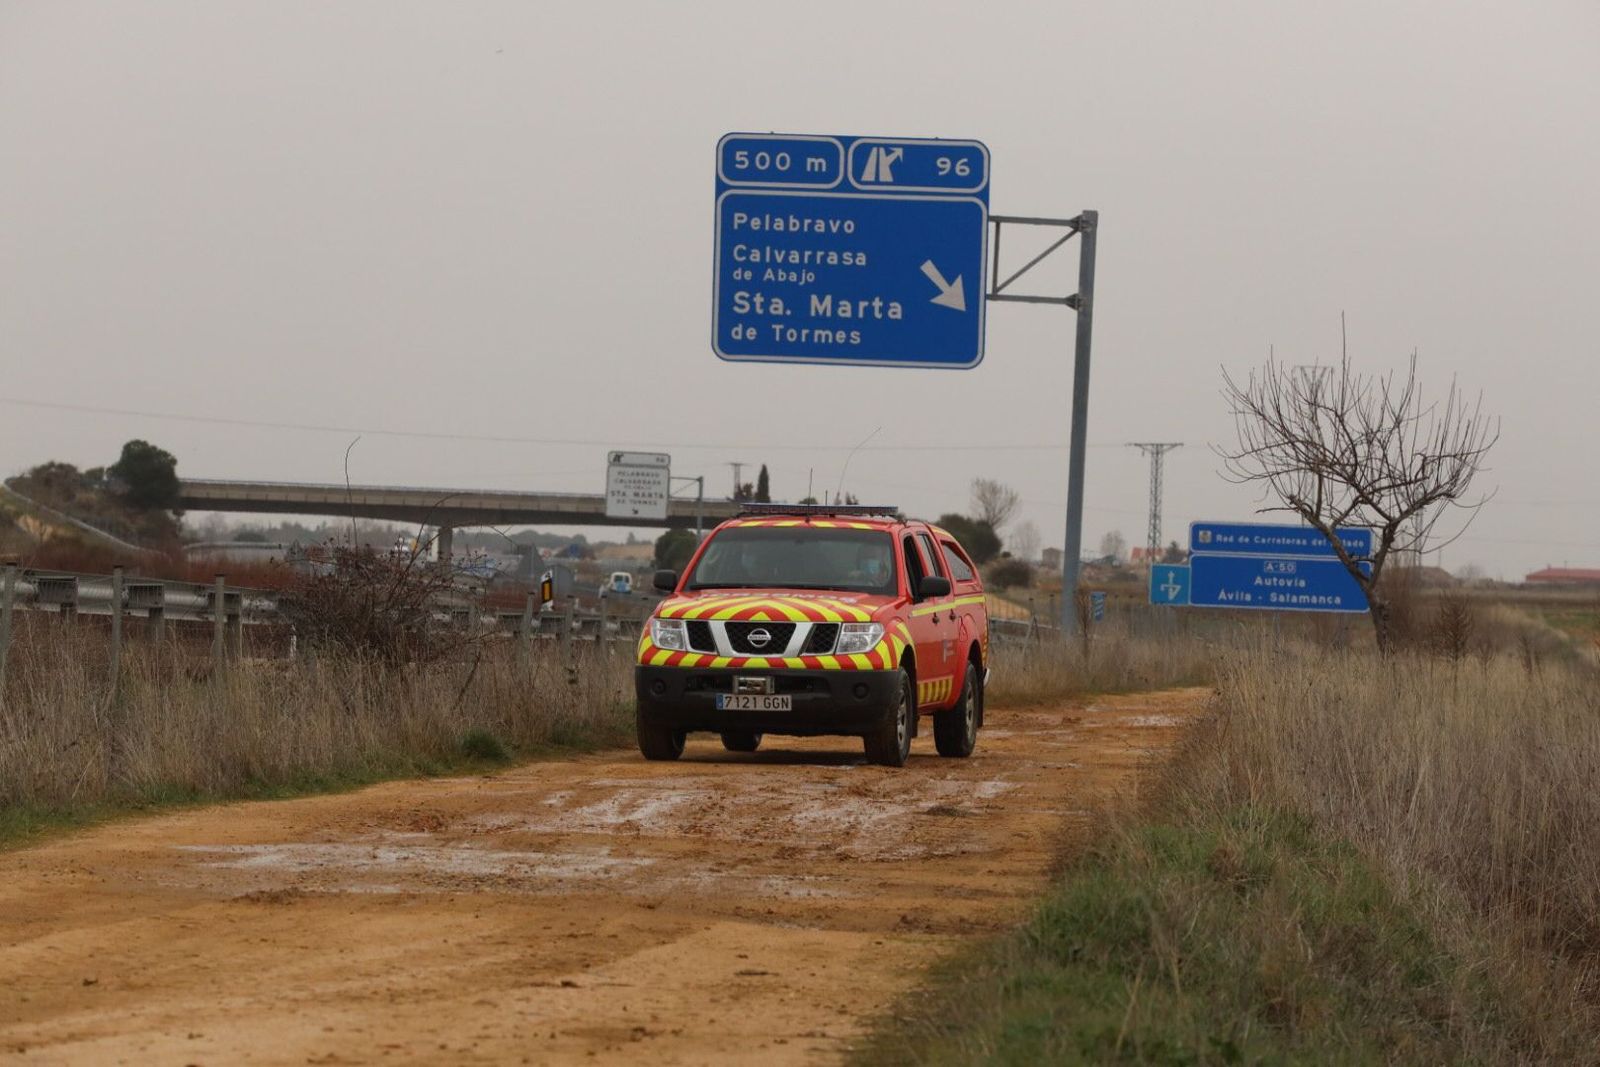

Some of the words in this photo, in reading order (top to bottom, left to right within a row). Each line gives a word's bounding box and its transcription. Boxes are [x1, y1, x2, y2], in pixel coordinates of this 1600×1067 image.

[735, 151, 791, 171] 500
[806, 156, 827, 172] m
[936, 157, 970, 176] 96
[732, 212, 855, 234] Pelabravo
[732, 244, 867, 267] Calvarrasa
[732, 267, 753, 281] de
[763, 269, 816, 286] Abajo
[732, 290, 792, 316] Sta.
[809, 294, 903, 320] Marta
[730, 323, 758, 341] de
[771, 324, 862, 345] Tormes
[1216, 533, 1234, 544] Red
[1238, 534, 1250, 544] de
[1254, 535, 1307, 546] Carreteras
[1311, 537, 1327, 547] del
[1254, 575, 1307, 588] Autovía
[1217, 588, 1252, 601] Ávila
[1269, 591, 1342, 605] Salamanca
[724, 696, 757, 709] 7121
[763, 696, 789, 709] GGN
